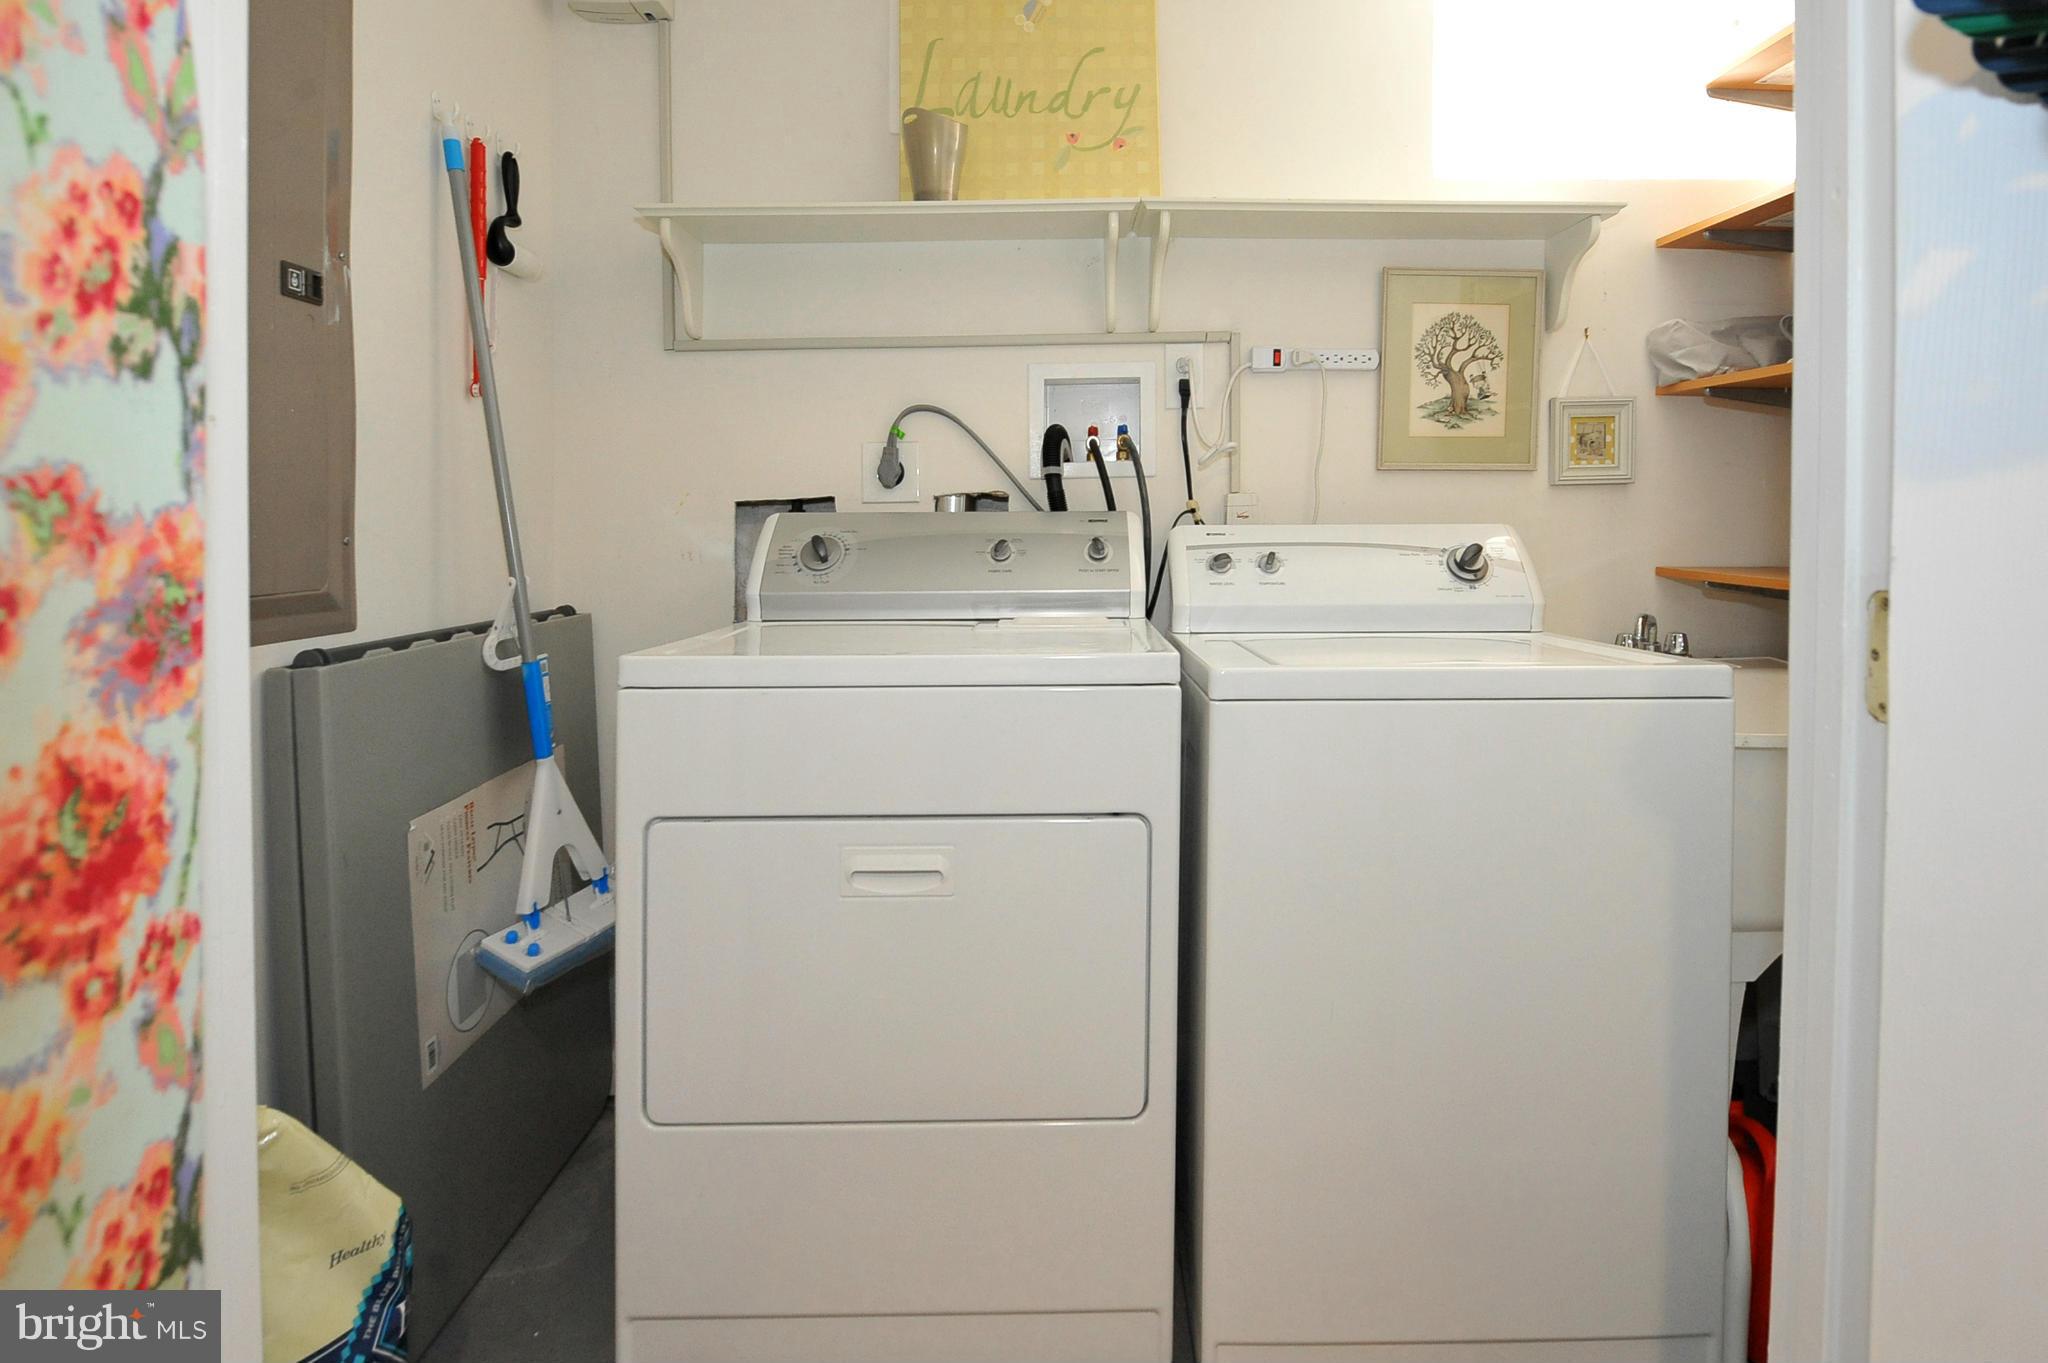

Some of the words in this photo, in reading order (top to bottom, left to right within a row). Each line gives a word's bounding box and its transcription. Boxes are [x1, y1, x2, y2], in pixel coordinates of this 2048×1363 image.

[913, 37, 1141, 151] Laundry
[363, 1314, 378, 1340] THE
[371, 1280, 395, 1313] BLUE
